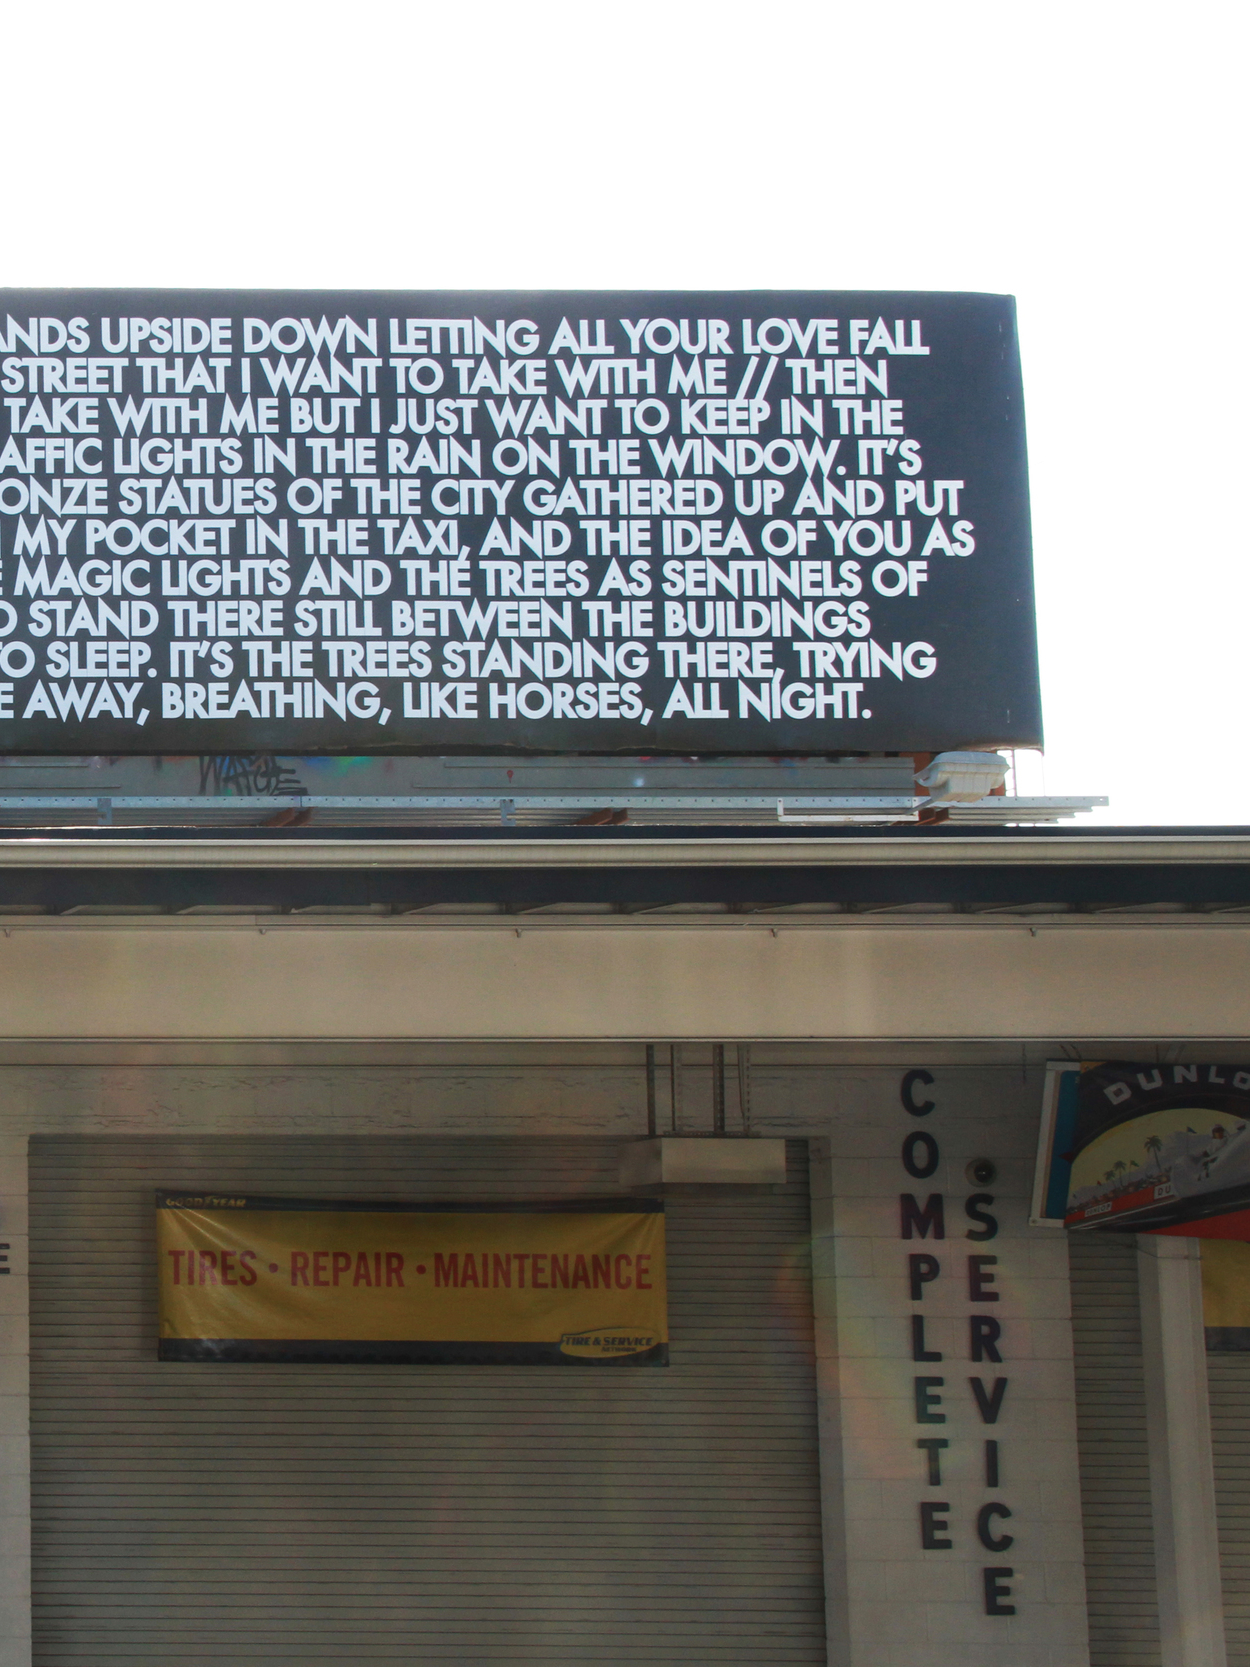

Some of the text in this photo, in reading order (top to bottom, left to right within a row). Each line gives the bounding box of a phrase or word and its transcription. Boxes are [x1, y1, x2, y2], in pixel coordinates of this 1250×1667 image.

[100, 317, 233, 353] UPSIDE
[242, 317, 378, 354] DOWN
[389, 318, 540, 354] LETTING
[547, 318, 615, 355] ALL
[618, 318, 735, 355] YOUR
[742, 318, 839, 355] LOVE
[849, 318, 931, 355] FALL
[0, 357, 130, 393] STREET
[135, 357, 232, 393] THAT
[240, 357, 251, 394] I
[259, 357, 383, 394] WANT
[388, 357, 445, 394] TO
[451, 358, 548, 395] TAKE
[553, 358, 657, 395] WITH
[667, 358, 728, 395] ME
[784, 358, 888, 395] THEN
[113, 437, 243, 474] LIGHTS
[253, 437, 297, 474] IN
[305, 437, 377, 474] THE
[387, 438, 482, 475] RAIN
[492, 438, 560, 475] ON
[568, 438, 641, 475] THE
[647, 439, 847, 475] WINDOW.
[857, 439, 923, 475] IT'S
[118, 478, 278, 515] STATUES
[286, 478, 343, 515] OF
[349, 478, 422, 515] THE
[430, 479, 516, 515] CITY
[522, 479, 724, 516] GATHERED
[734, 479, 785, 516] UP
[791, 479, 885, 516] AND
[894, 479, 965, 516] PUT
[12, 518, 78, 555] MY
[85, 518, 237, 555] POCKET
[245, 518, 289, 555] IN
[297, 518, 370, 556] THE
[376, 518, 471, 562] TAXI,
[478, 519, 572, 556] AND
[579, 519, 652, 556] THE
[661, 519, 754, 556] IDEA
[760, 519, 817, 556] OF
[822, 520, 912, 556] YOU
[920, 520, 976, 556] AS
[45, 640, 158, 677] SLEEP.
[169, 640, 234, 677] IT'S
[241, 640, 314, 678] THE
[321, 640, 433, 678] TREES
[441, 641, 650, 678] STANDING
[656, 641, 785, 684] THERE,
[792, 641, 937, 678] TRYING
[22, 681, 151, 725] AWAY,
[161, 682, 392, 725] BREATHING,
[403, 682, 479, 719] LIKE
[488, 682, 654, 725] HORSES,
[662, 682, 730, 719] ALL
[738, 682, 872, 719] NIGHT.
[167, 1250, 653, 1291] TIRES REPAIR MAINTENANCE
[565, 1337, 653, 1346] TIRE & SERVICE
